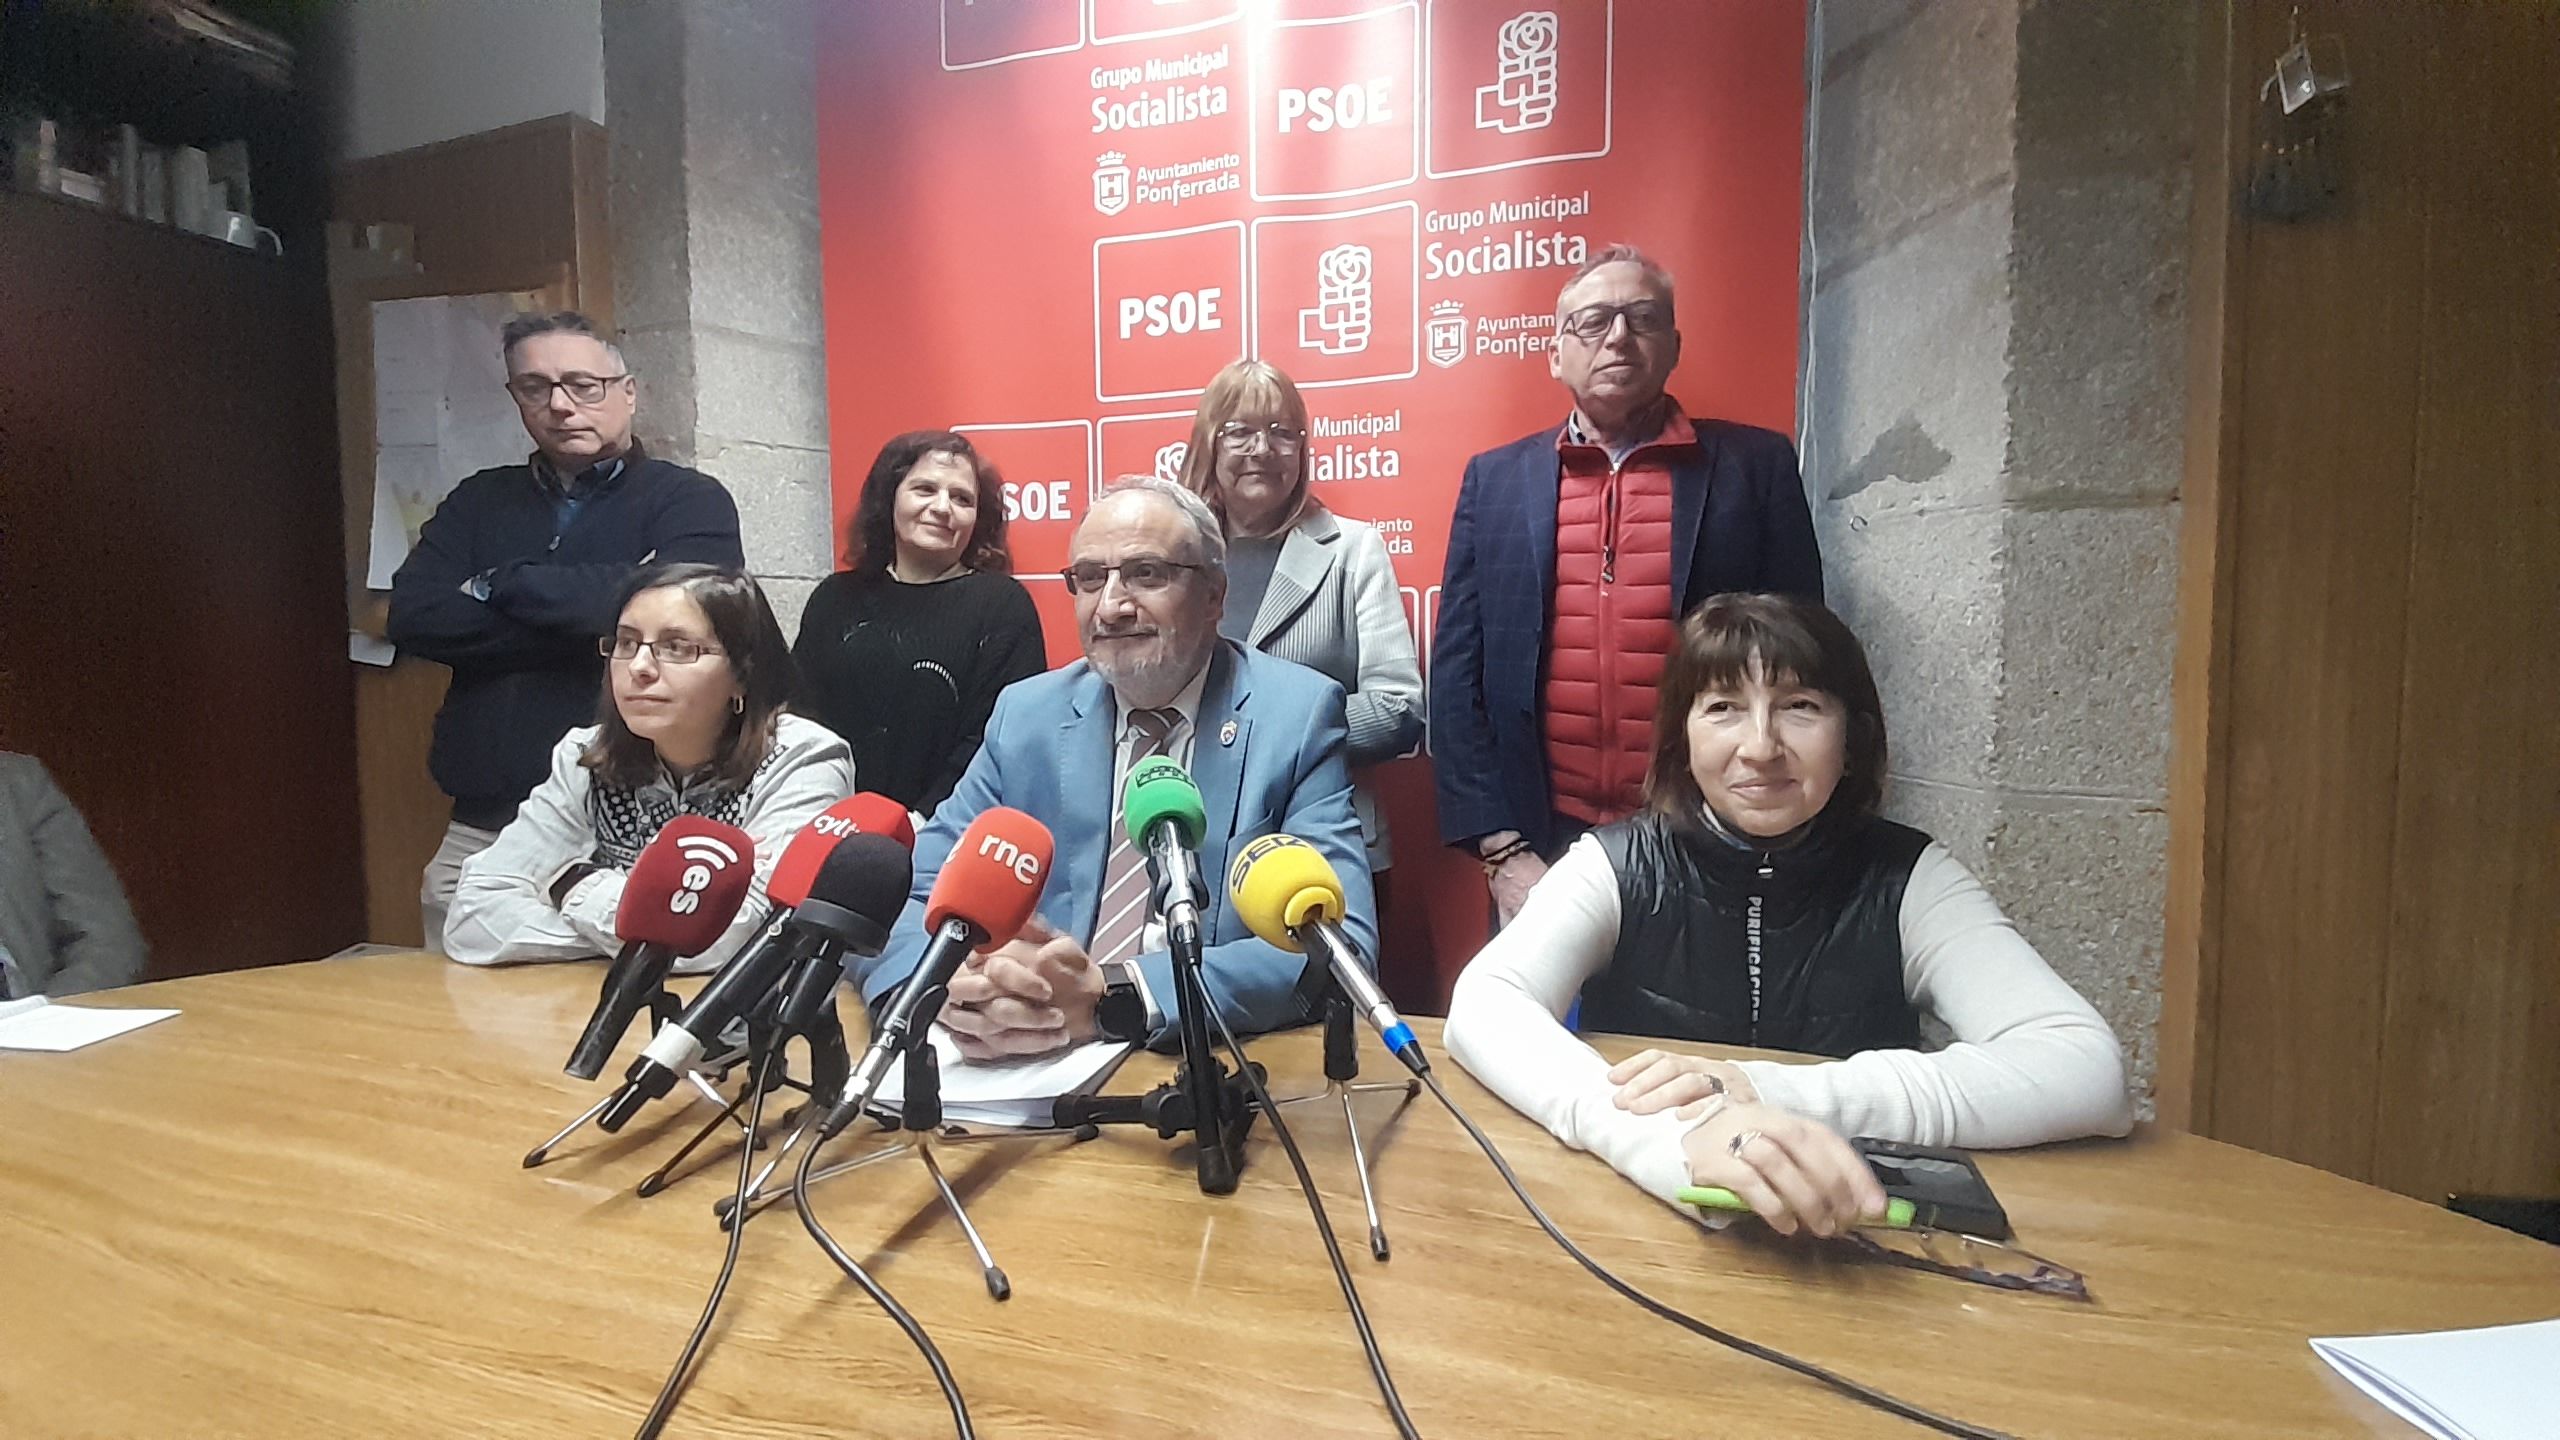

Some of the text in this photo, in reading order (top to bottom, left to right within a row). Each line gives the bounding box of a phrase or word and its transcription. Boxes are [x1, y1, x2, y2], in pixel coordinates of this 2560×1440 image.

[1090, 43, 1229, 91] Grupo Municipal
[1091, 84, 1228, 133] Socialista
[1278, 76, 1392, 133] PSOE
[1136, 153, 1240, 184] Ayuntamiento
[1136, 171, 1240, 206] Ponferrada
[1425, 190, 1589, 235] Grupo Municipal
[1425, 230, 1587, 280] Socialista
[1119, 287, 1222, 339] PSOE
[1476, 314, 1556, 335] Ayuntam
[1312, 409, 1401, 439] Municipal
[1308, 444, 1400, 482] ialista
[1001, 480, 1071, 521] SOE
[978, 833, 1040, 886] rne
[1232, 835, 1309, 894] SER
